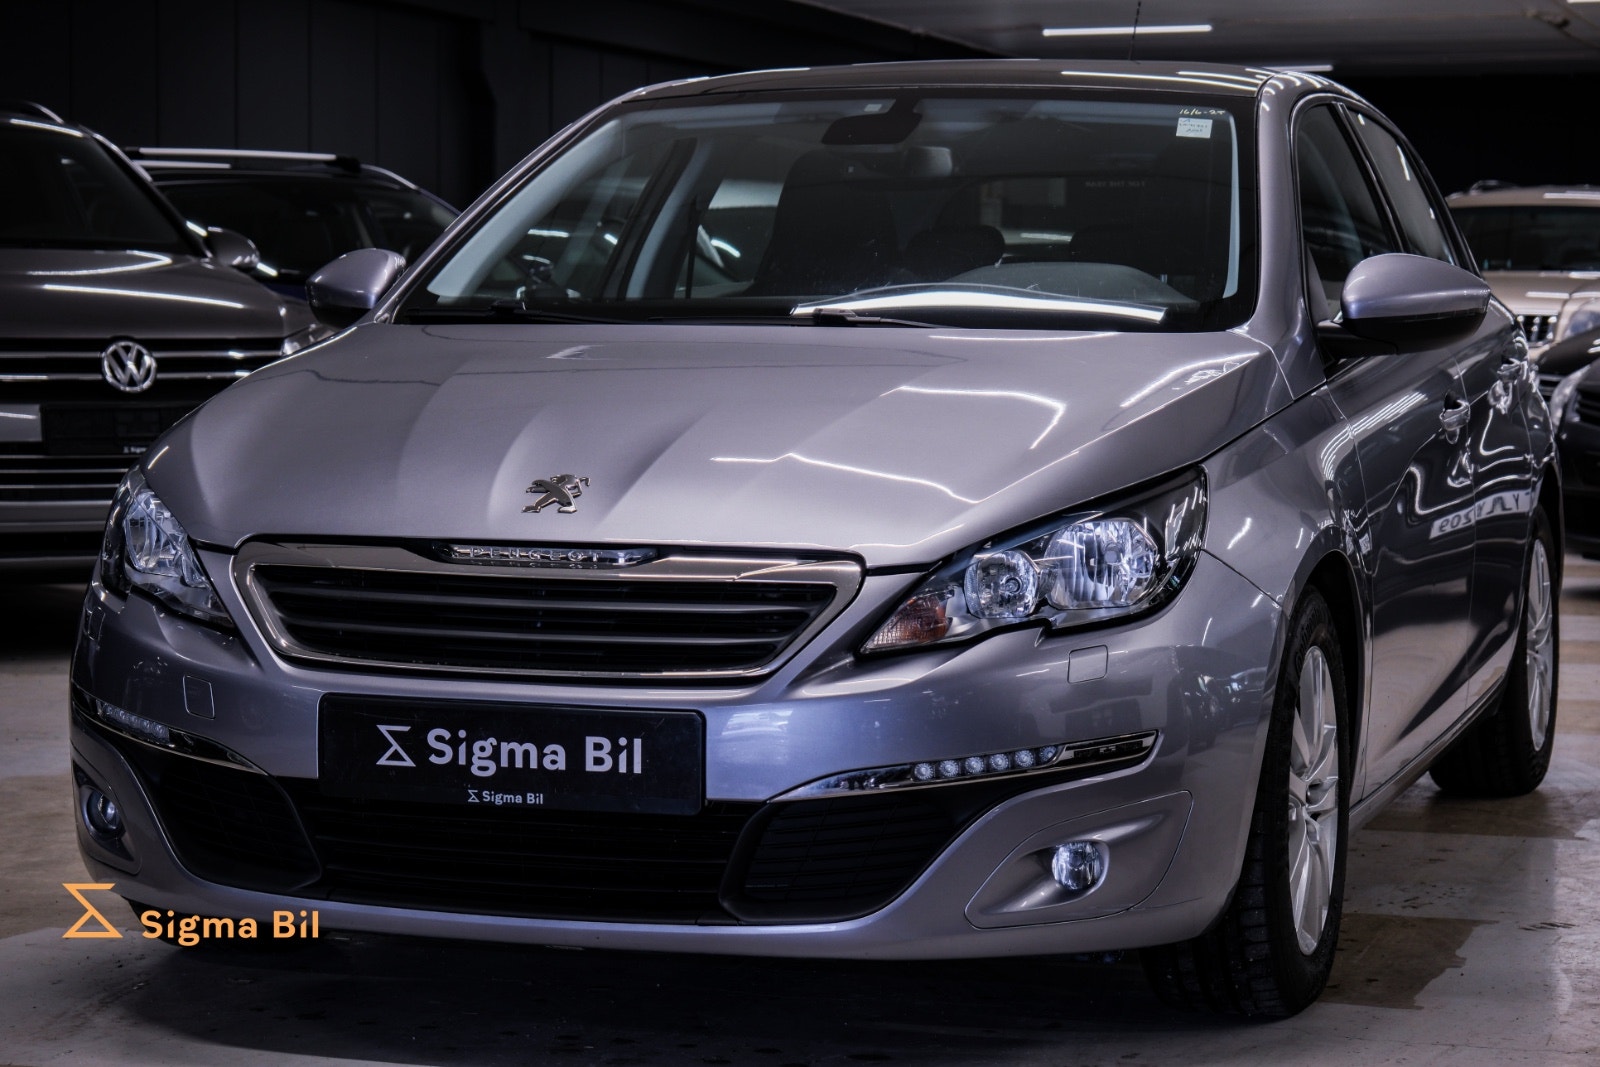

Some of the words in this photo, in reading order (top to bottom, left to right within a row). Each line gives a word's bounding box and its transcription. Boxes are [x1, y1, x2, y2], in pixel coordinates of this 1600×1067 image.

[426, 728, 566, 778] Sigma
[585, 736, 642, 774] Bil
[482, 790, 523, 806] Sigma
[526, 792, 544, 805] Bil
